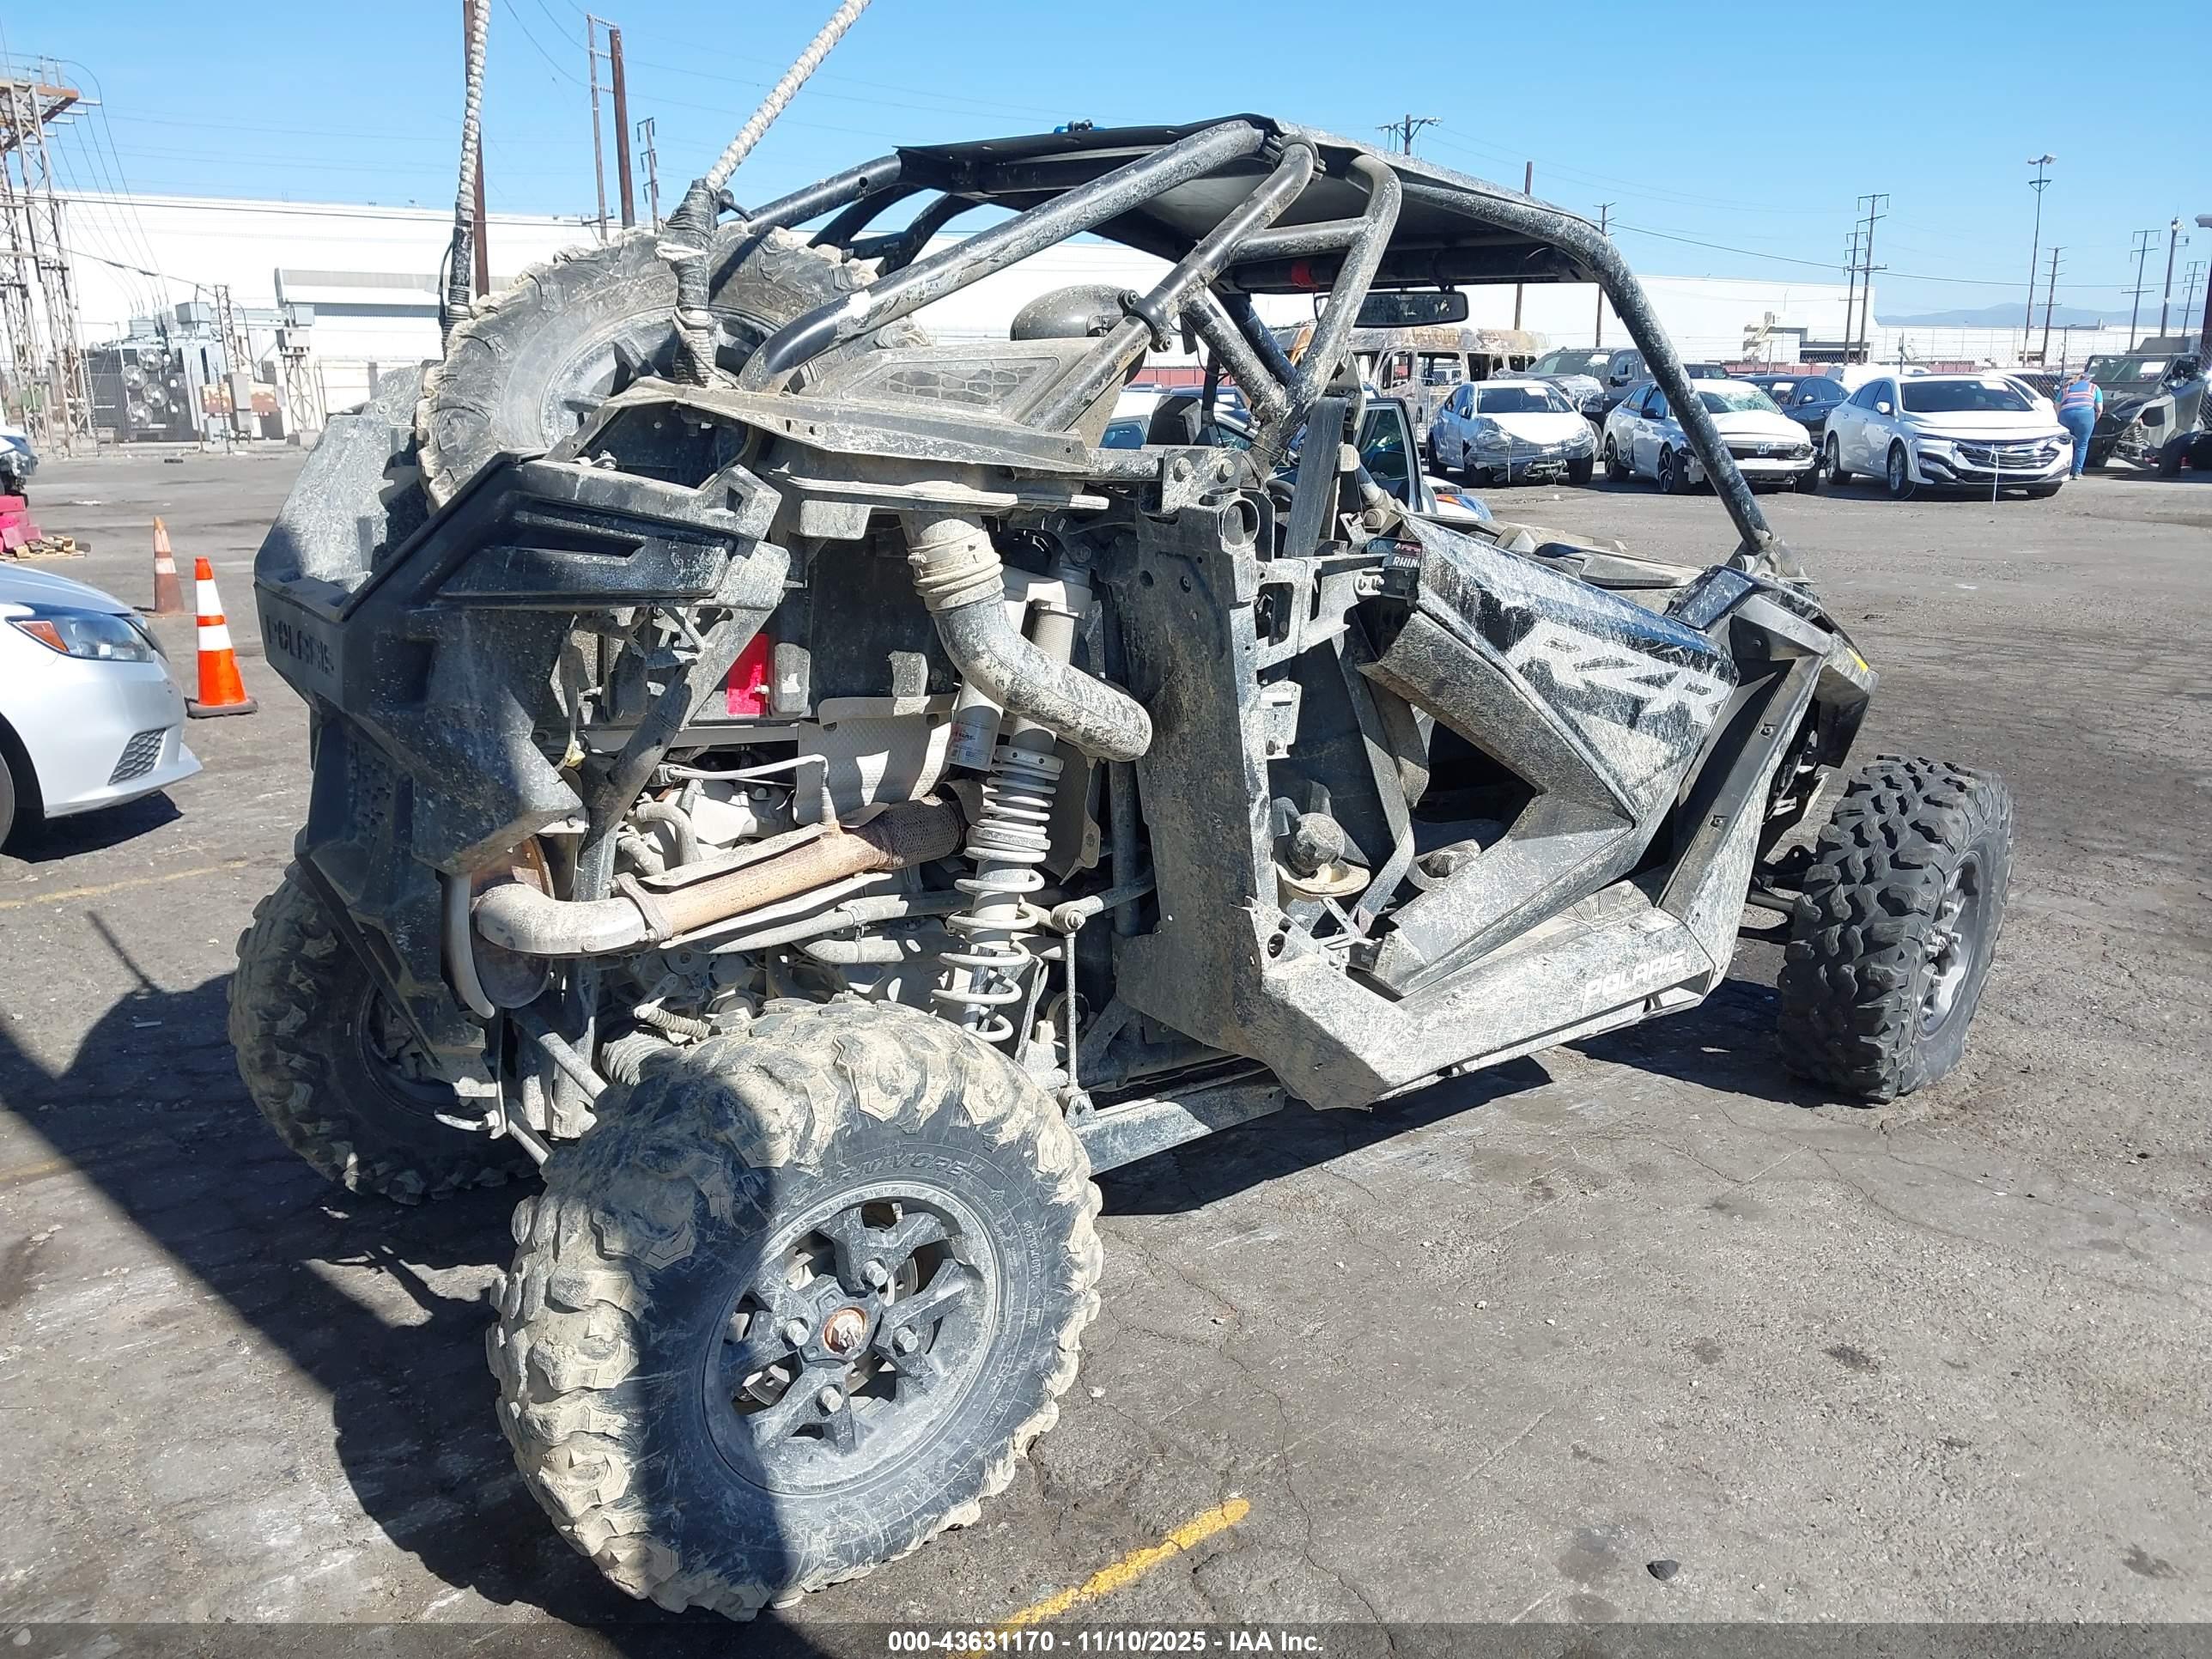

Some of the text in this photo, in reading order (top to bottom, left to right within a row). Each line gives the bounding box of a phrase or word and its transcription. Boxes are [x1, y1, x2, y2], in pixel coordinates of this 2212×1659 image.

[1392, 556, 1420, 568] RHIN
[266, 615, 334, 673] POLARIS
[1506, 617, 1731, 728] RZR
[1583, 948, 1687, 1006] POLARIS
